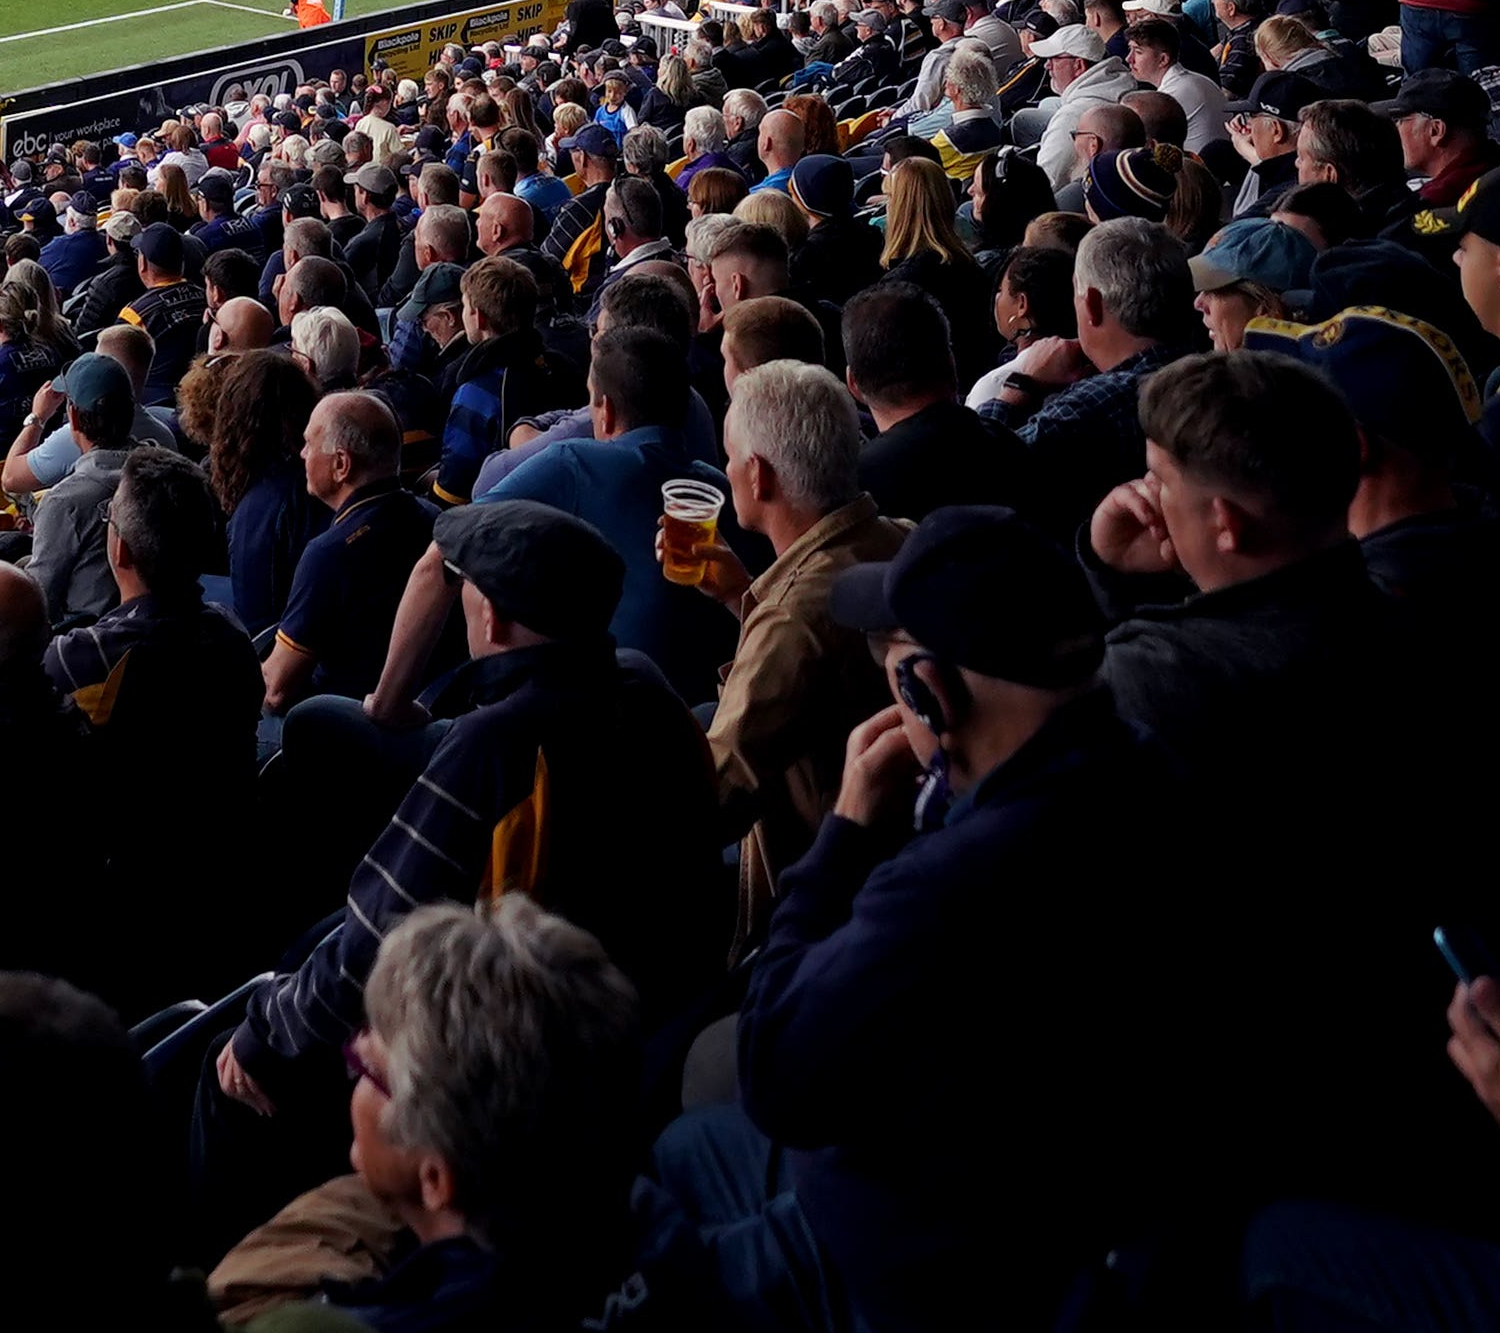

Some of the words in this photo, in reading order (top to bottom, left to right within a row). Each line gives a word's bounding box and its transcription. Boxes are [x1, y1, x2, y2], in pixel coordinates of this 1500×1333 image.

[469, 12, 508, 28] Blackpole
[517, 3, 543, 21] SKIP
[378, 32, 420, 49] Blackpole
[429, 23, 457, 42] SKIP
[76, 117, 121, 137] workplace
[13, 130, 47, 158] ebc
